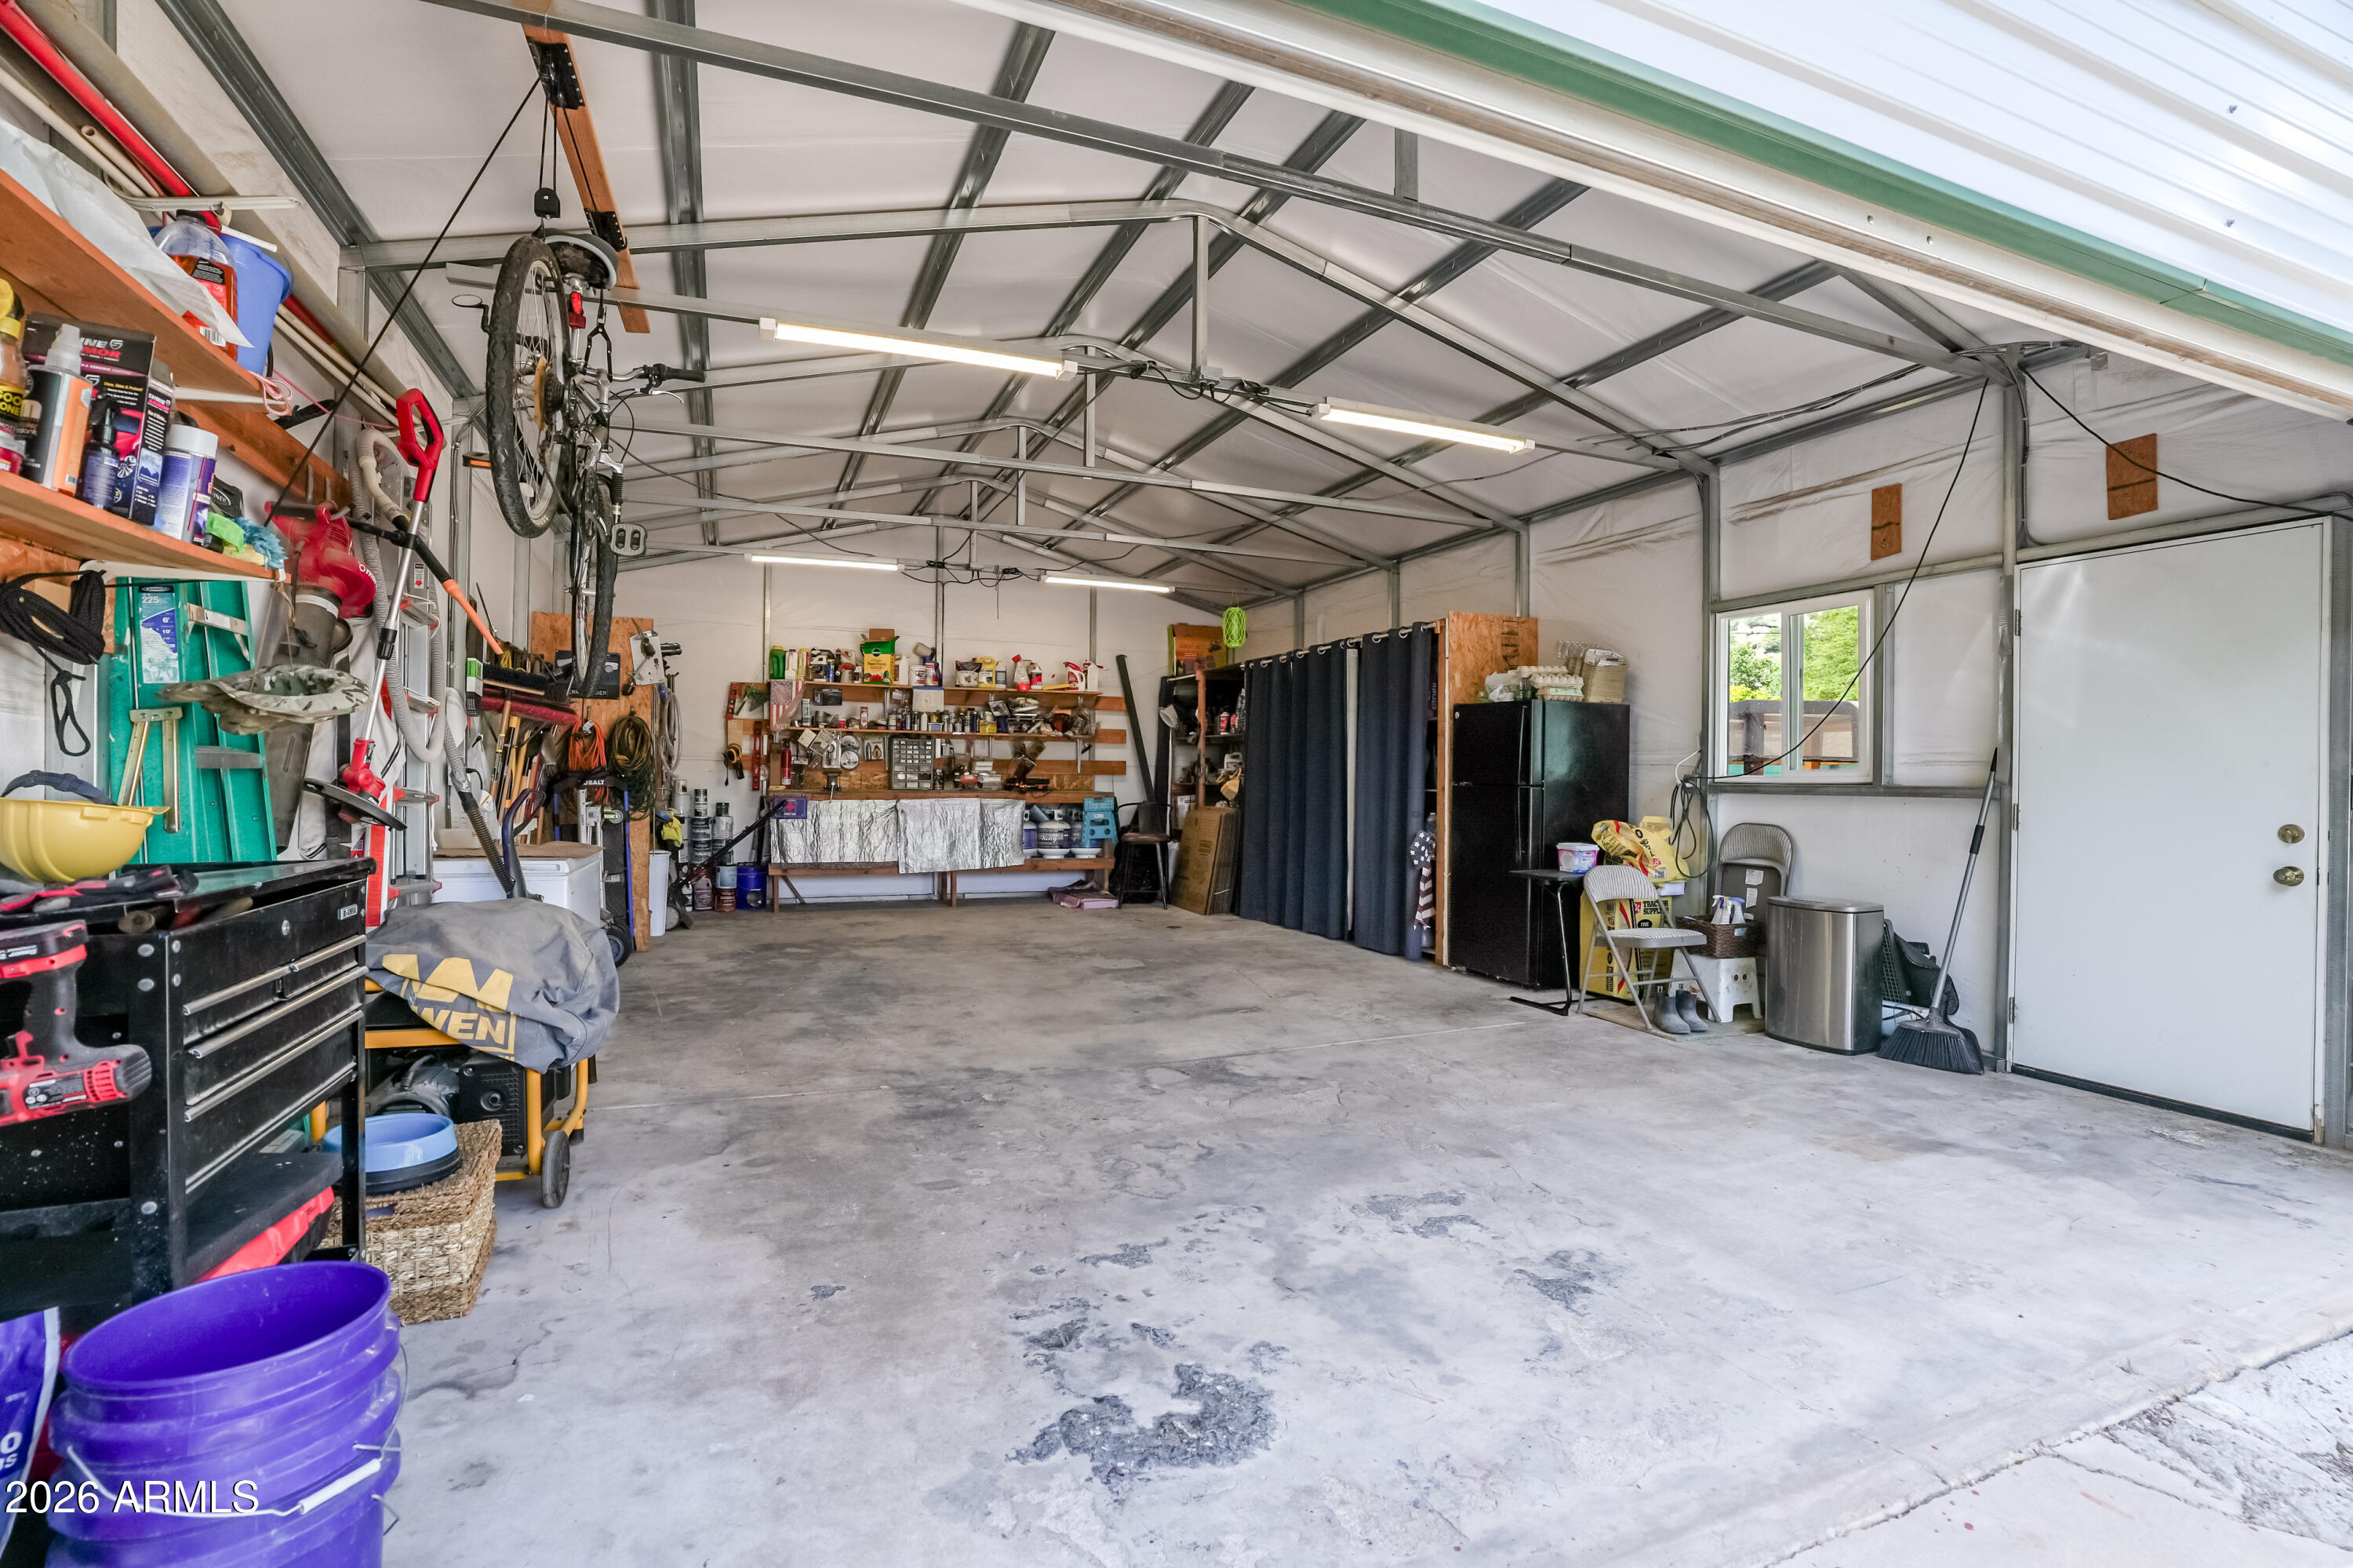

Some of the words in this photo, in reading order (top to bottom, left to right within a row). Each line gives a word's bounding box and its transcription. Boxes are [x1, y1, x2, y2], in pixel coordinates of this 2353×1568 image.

[79, 337, 108, 348] INE
[0, 401, 20, 416] ONE
[412, 1005, 506, 1046] WEN
